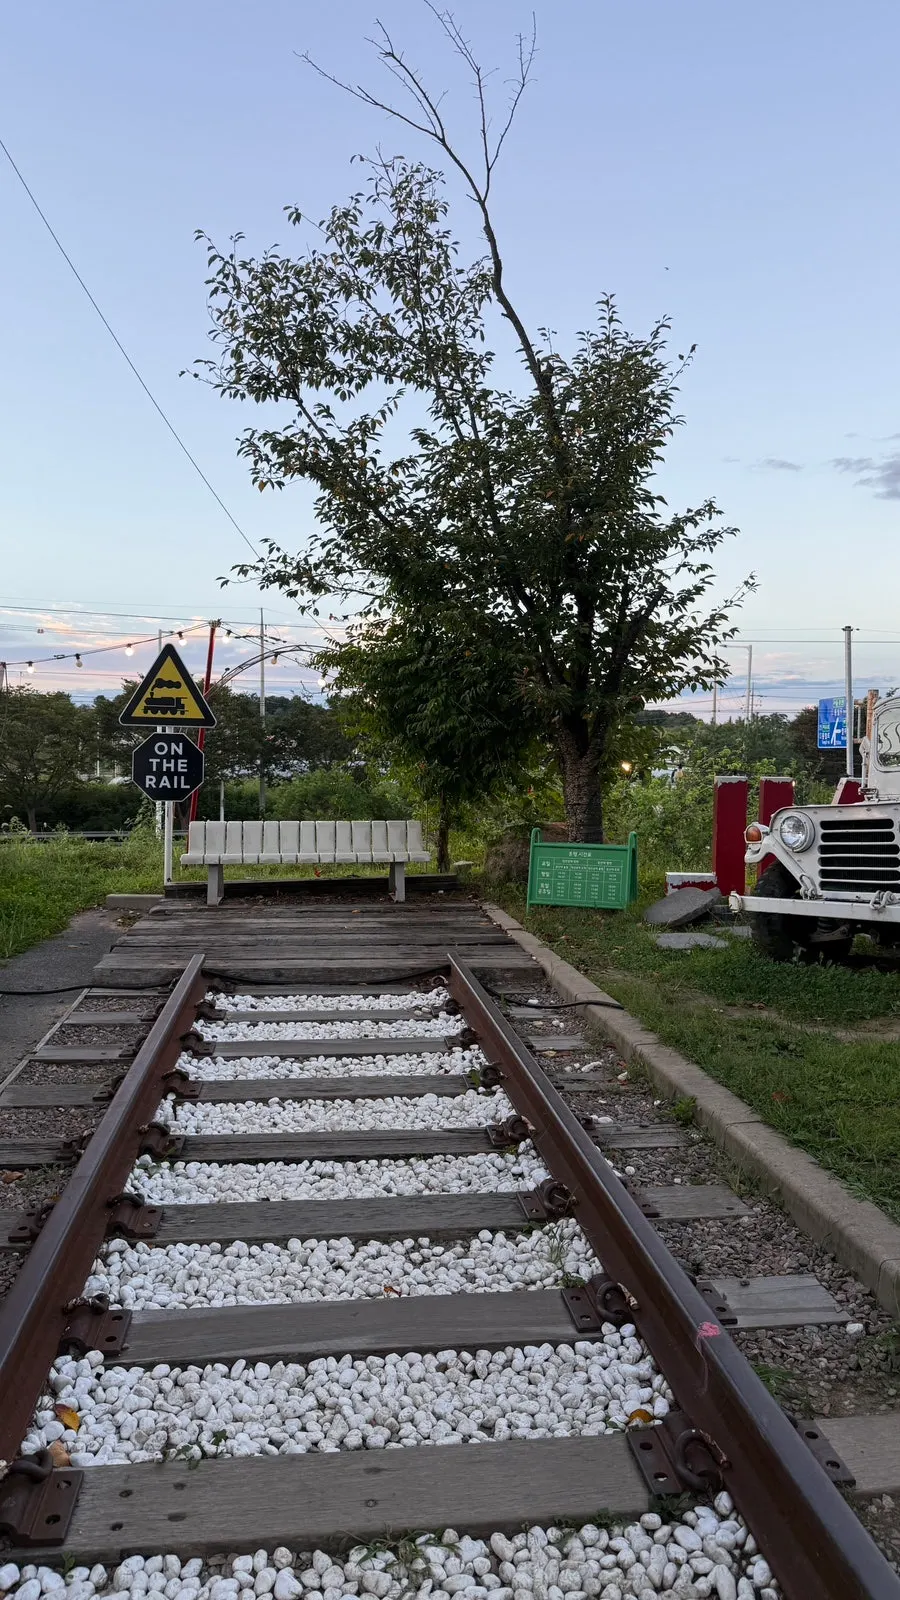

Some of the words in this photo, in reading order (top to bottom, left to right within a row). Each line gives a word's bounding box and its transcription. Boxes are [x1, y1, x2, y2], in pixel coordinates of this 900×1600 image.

[154, 742, 183, 756] ON
[149, 758, 188, 772] THE
[145, 775, 191, 789] RAIL
